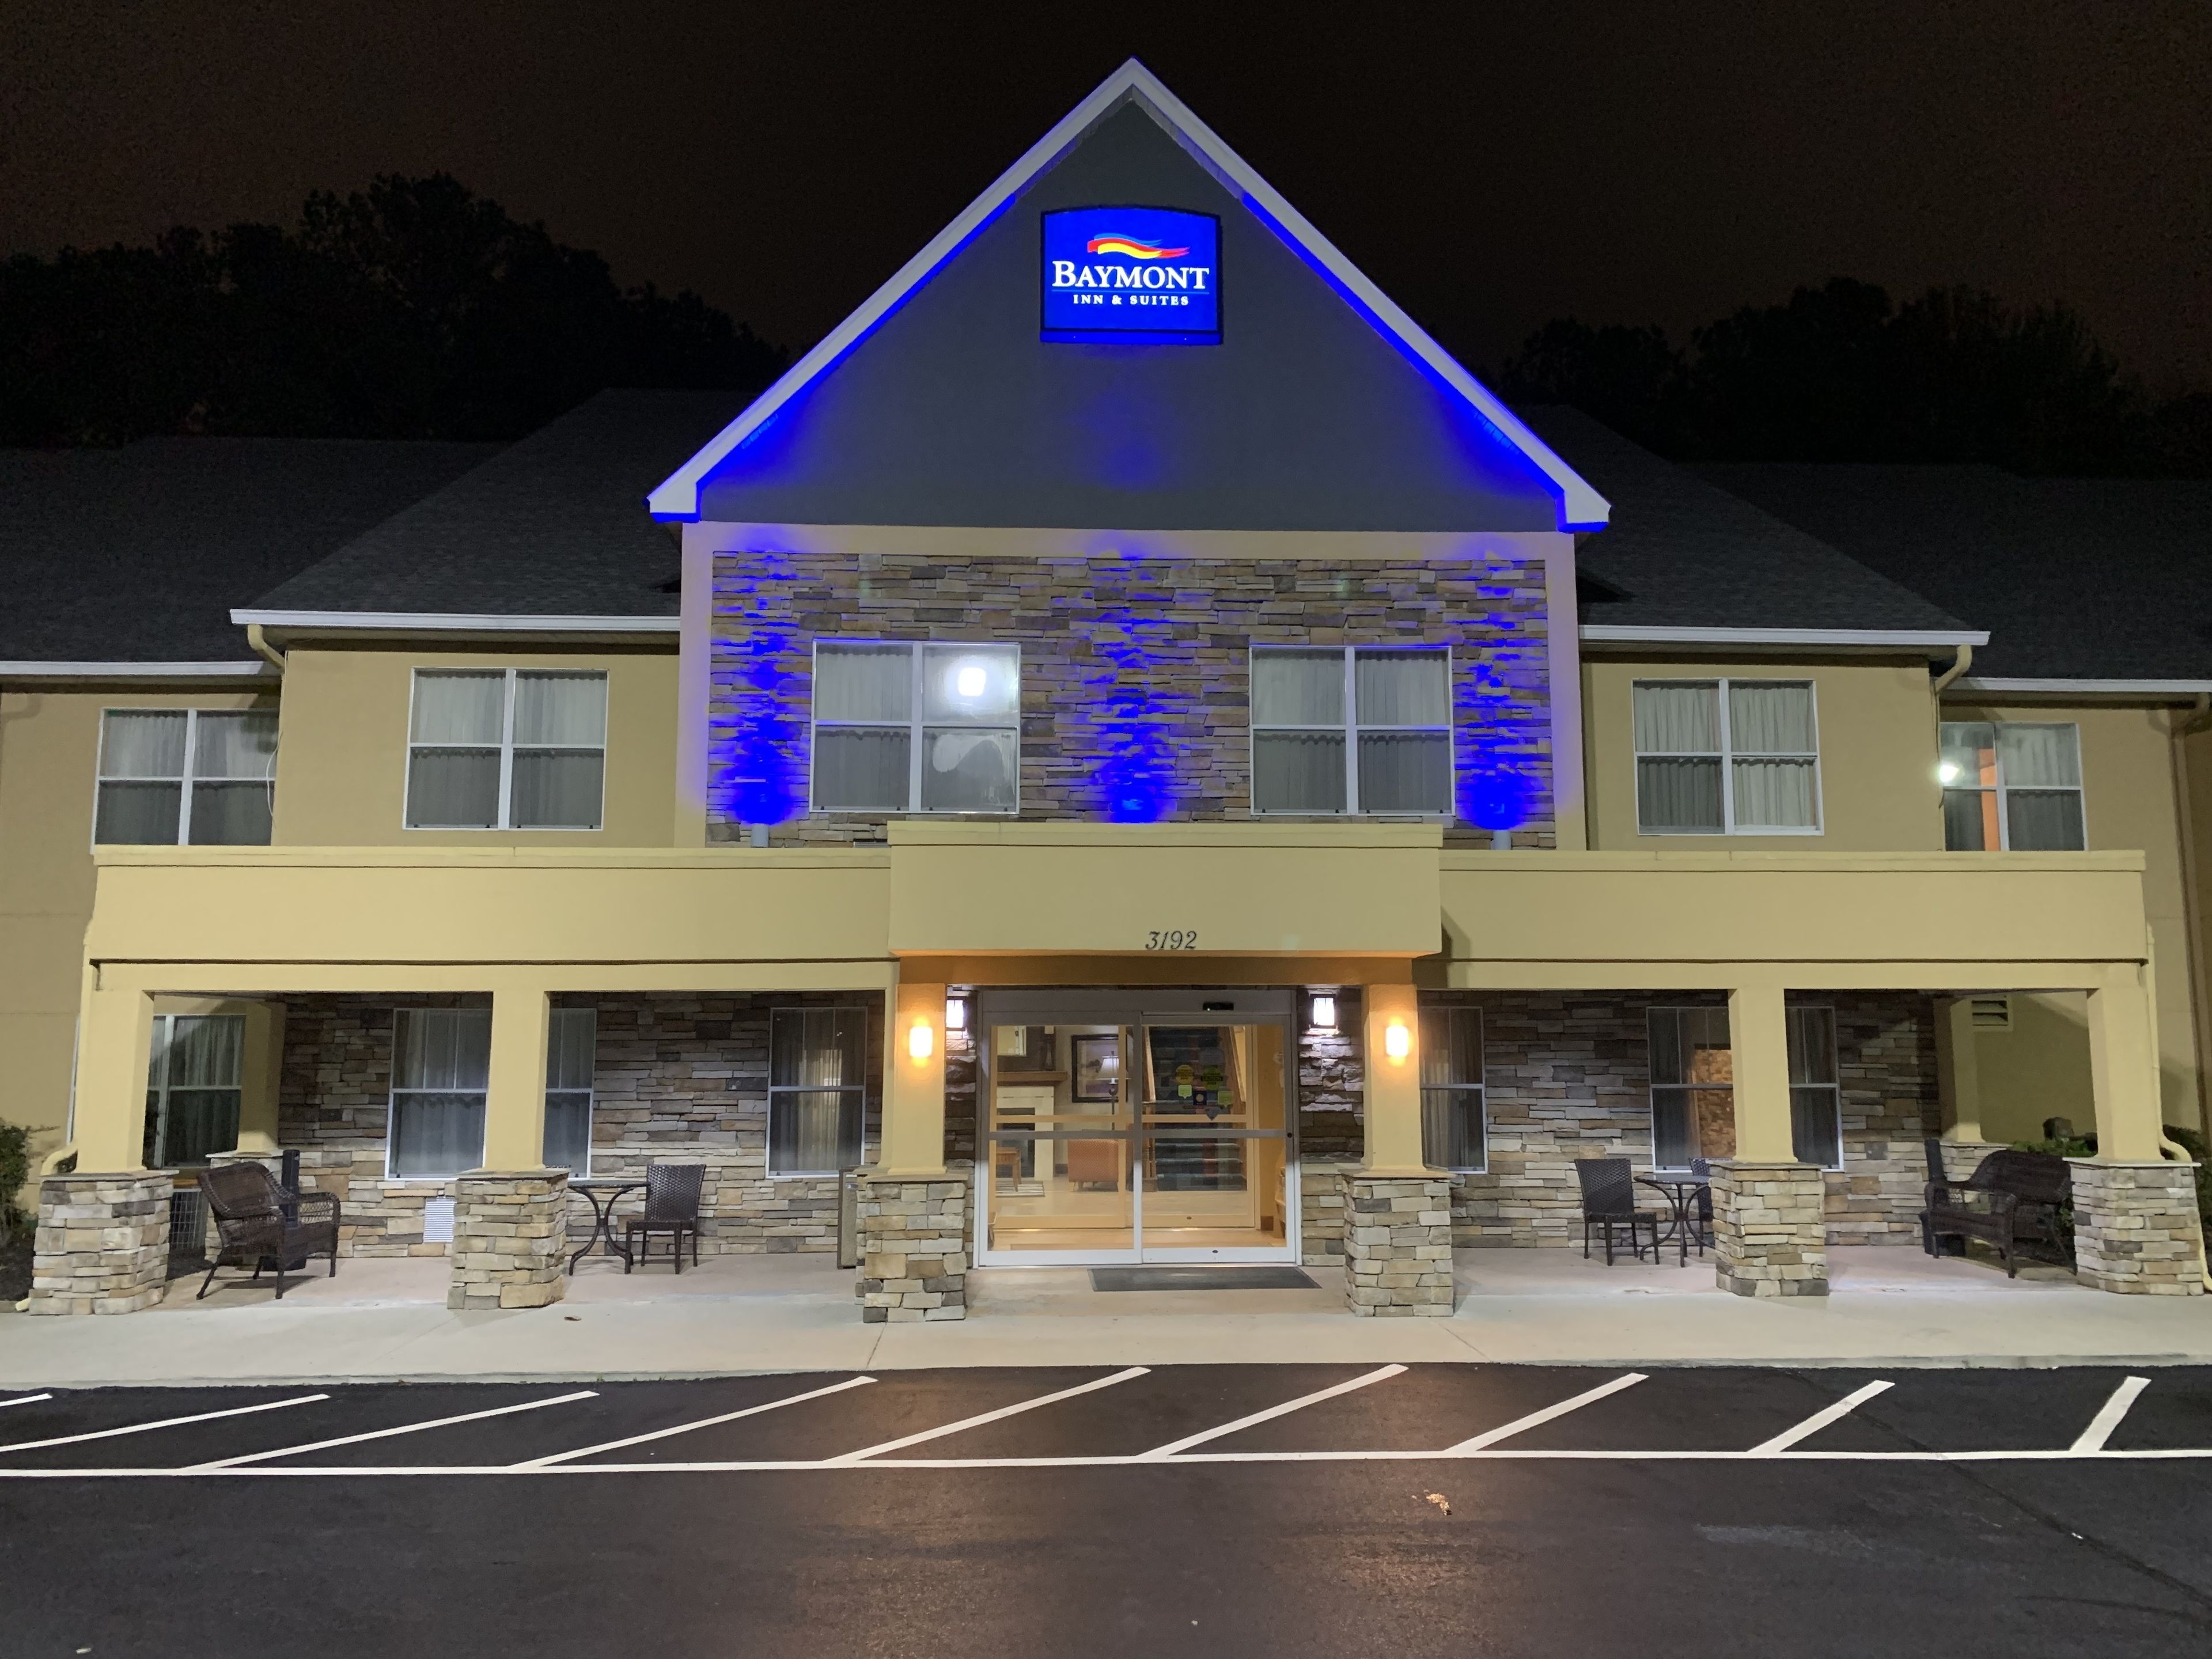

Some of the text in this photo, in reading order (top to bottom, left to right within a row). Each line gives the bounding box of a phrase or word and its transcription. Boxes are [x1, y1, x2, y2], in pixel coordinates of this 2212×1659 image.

[1052, 260, 1210, 289] BAYMONT
[1073, 294, 1189, 306] INN & SUITES
[1145, 930, 1197, 949] 3192
